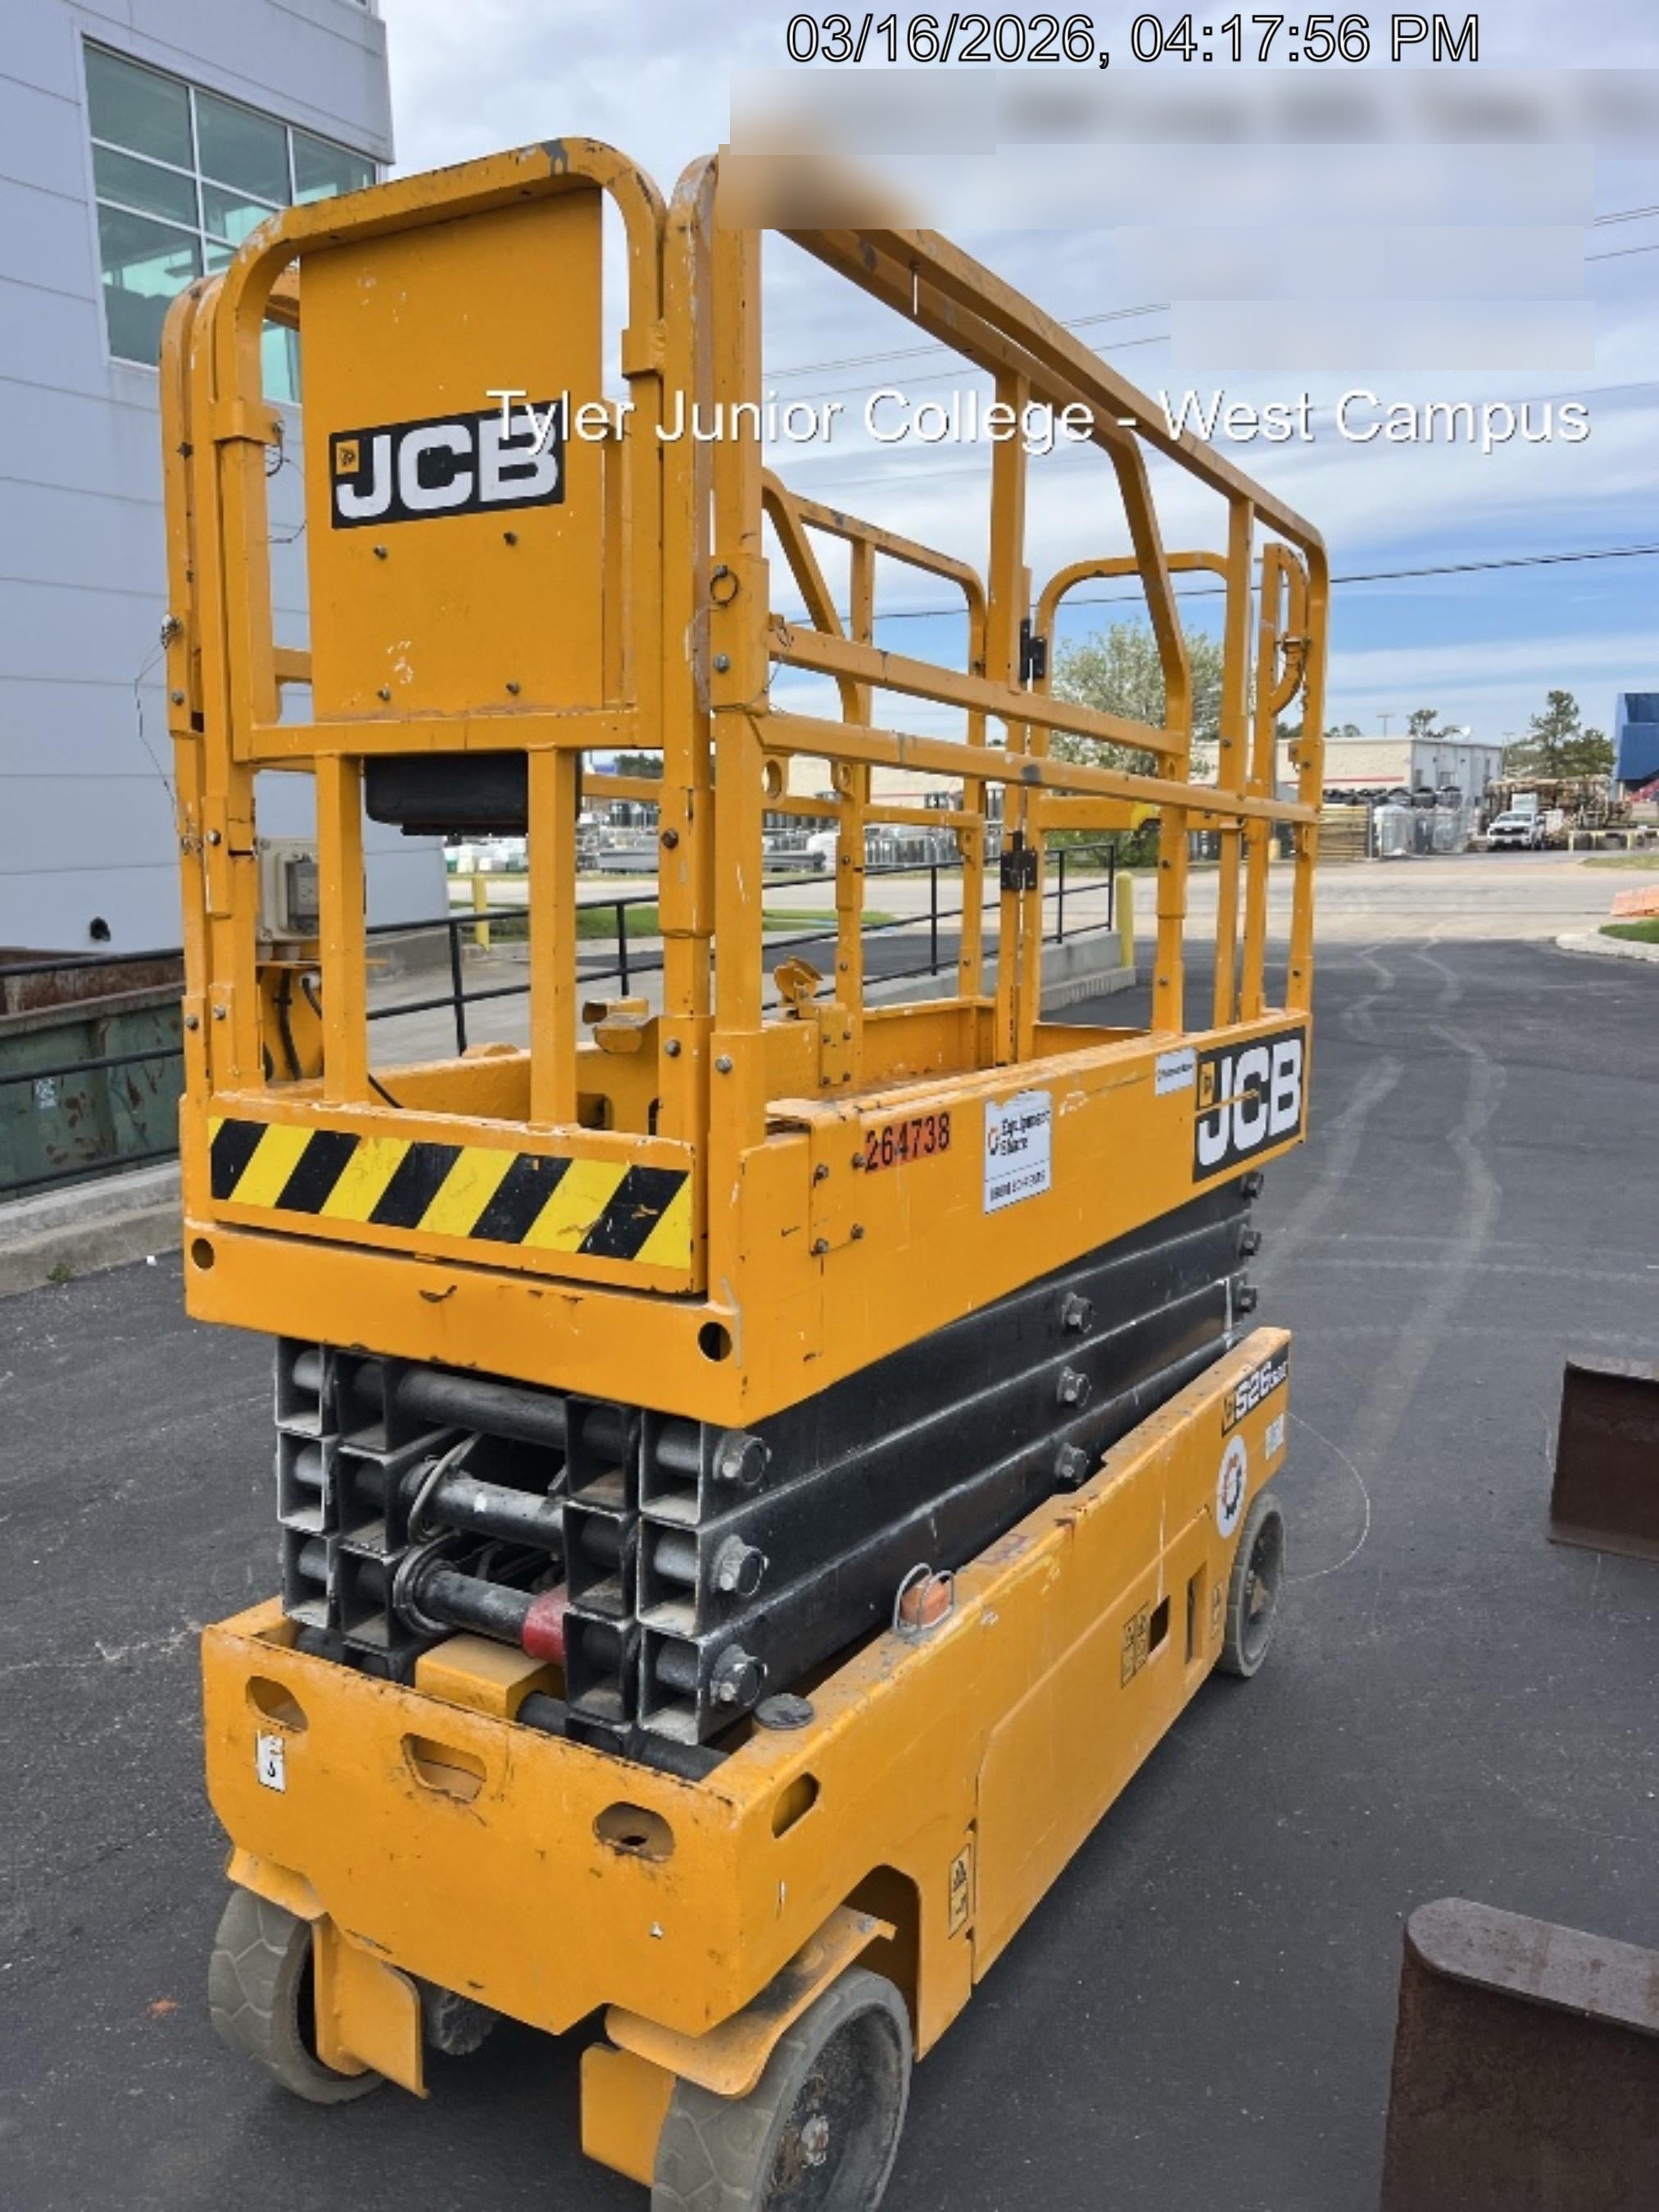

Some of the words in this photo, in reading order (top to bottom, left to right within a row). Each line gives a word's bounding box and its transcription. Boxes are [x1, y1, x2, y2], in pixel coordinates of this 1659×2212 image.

[336, 411, 560, 519] JCB
[864, 1110, 950, 1173] 264738
[1199, 1039, 1302, 1166] JCB
